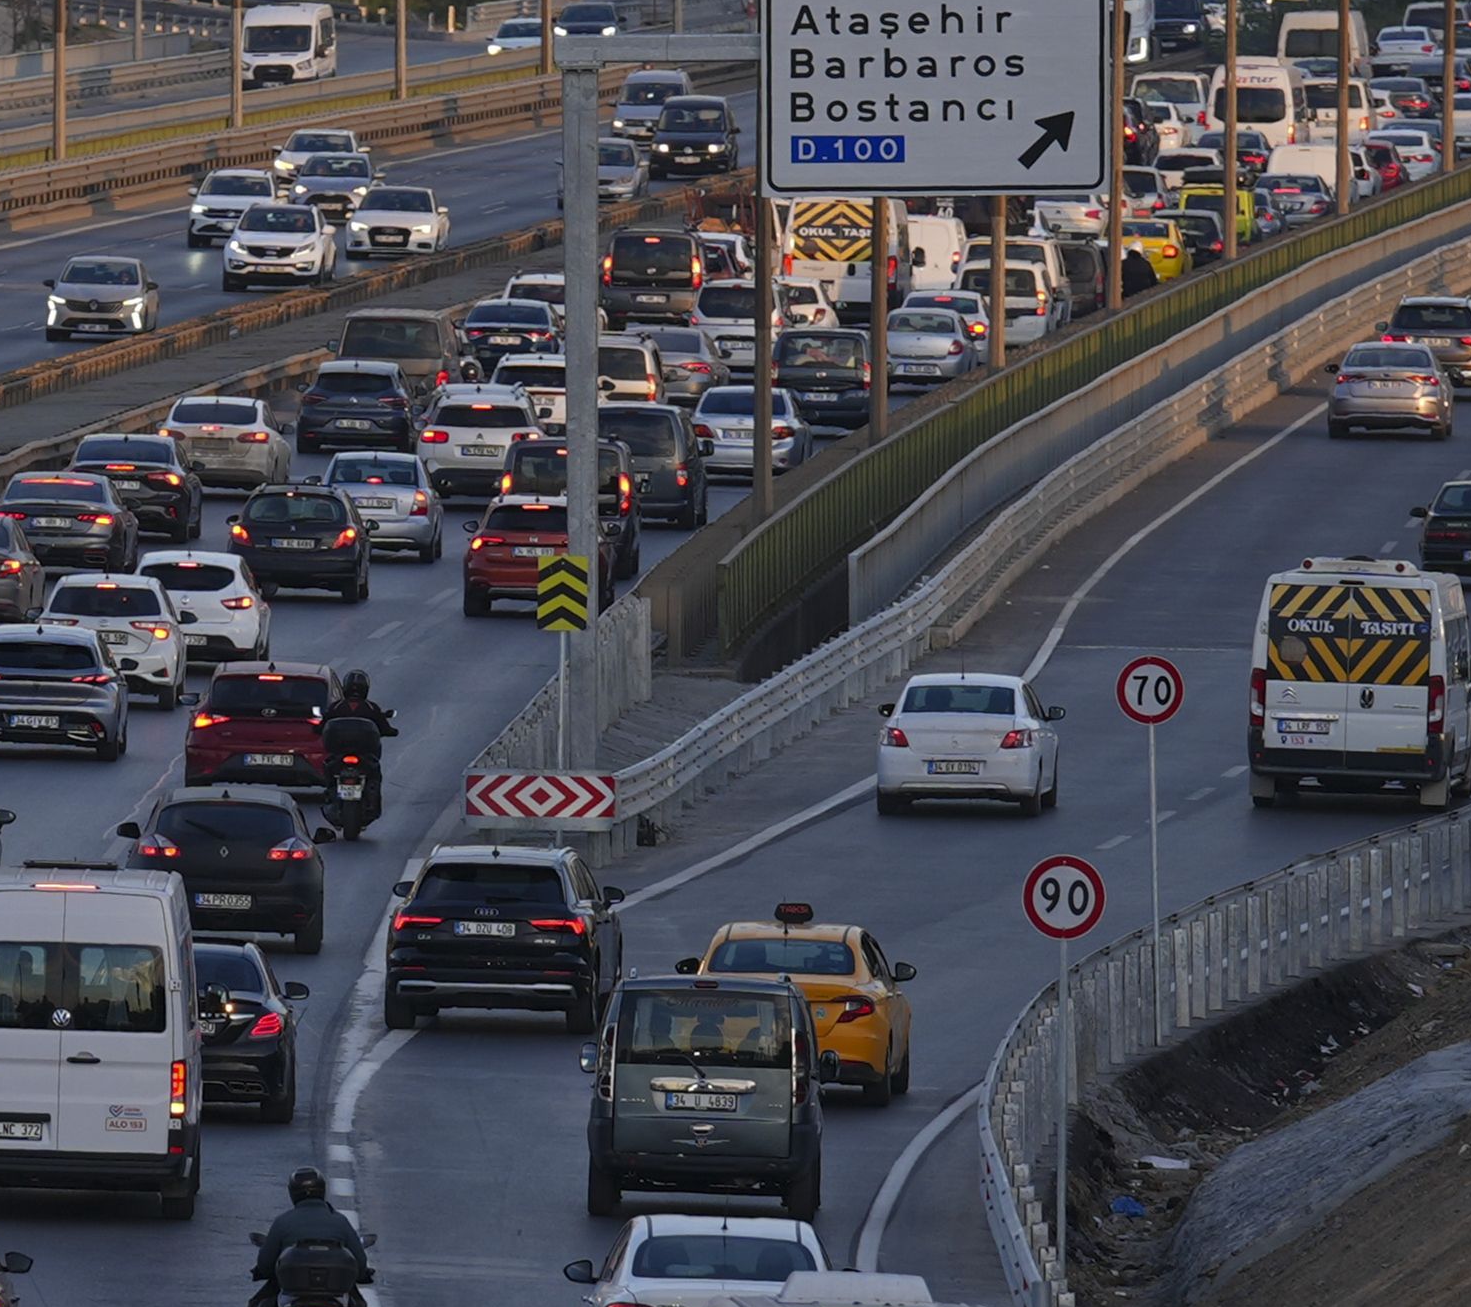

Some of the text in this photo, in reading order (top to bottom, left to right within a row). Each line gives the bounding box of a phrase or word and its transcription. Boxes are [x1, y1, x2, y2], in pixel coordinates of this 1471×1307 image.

[790, 3, 1012, 39] Ataşehir
[790, 48, 1026, 79] Barbaros
[790, 92, 1014, 122] Bostancı
[798, 138, 900, 161] D.100
[1287, 618, 1416, 637] OKUL TAŞITI
[1132, 675, 1171, 706] 70
[1040, 877, 1090, 916] 90
[673, 1095, 686, 1106] 34
[708, 1096, 735, 1109] 4839
[20, 1124, 40, 1136] 372
